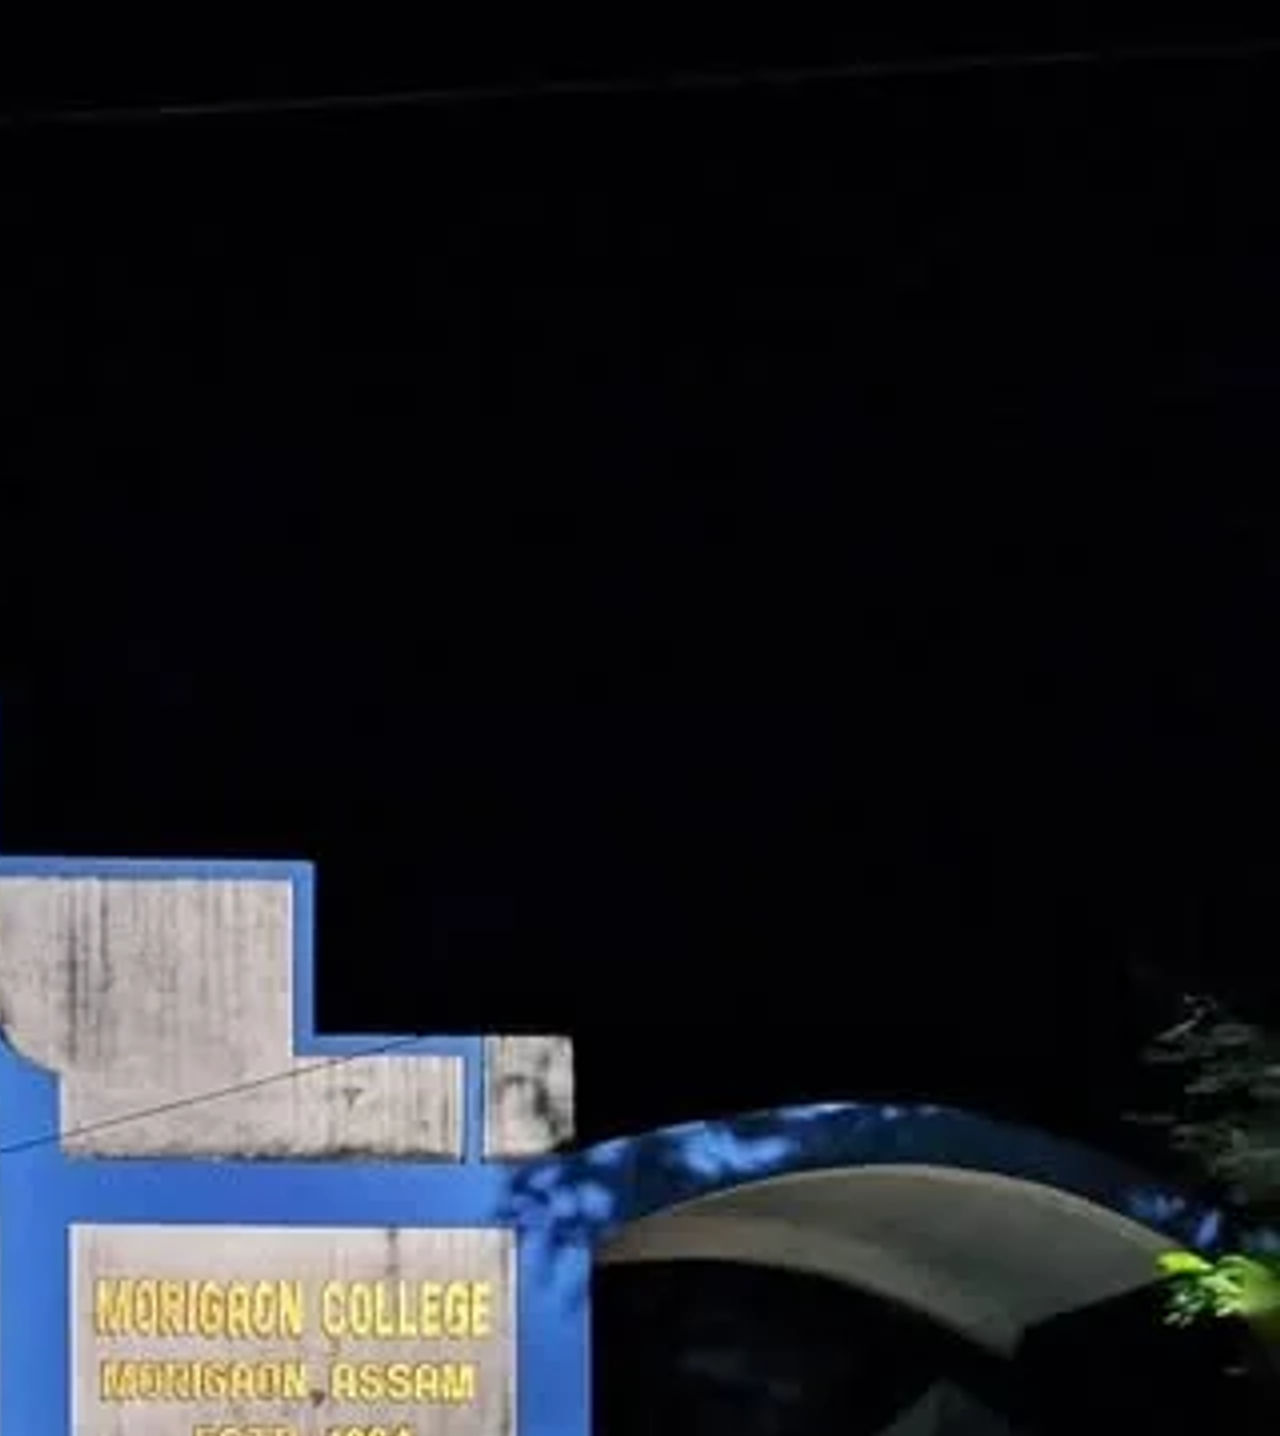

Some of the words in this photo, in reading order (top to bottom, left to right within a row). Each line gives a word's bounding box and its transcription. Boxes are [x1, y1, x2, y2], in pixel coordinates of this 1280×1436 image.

[95, 1279, 304, 1338] MORIGAON
[321, 1279, 494, 1338] COLLEGE
[329, 1360, 478, 1404] ASSAM
